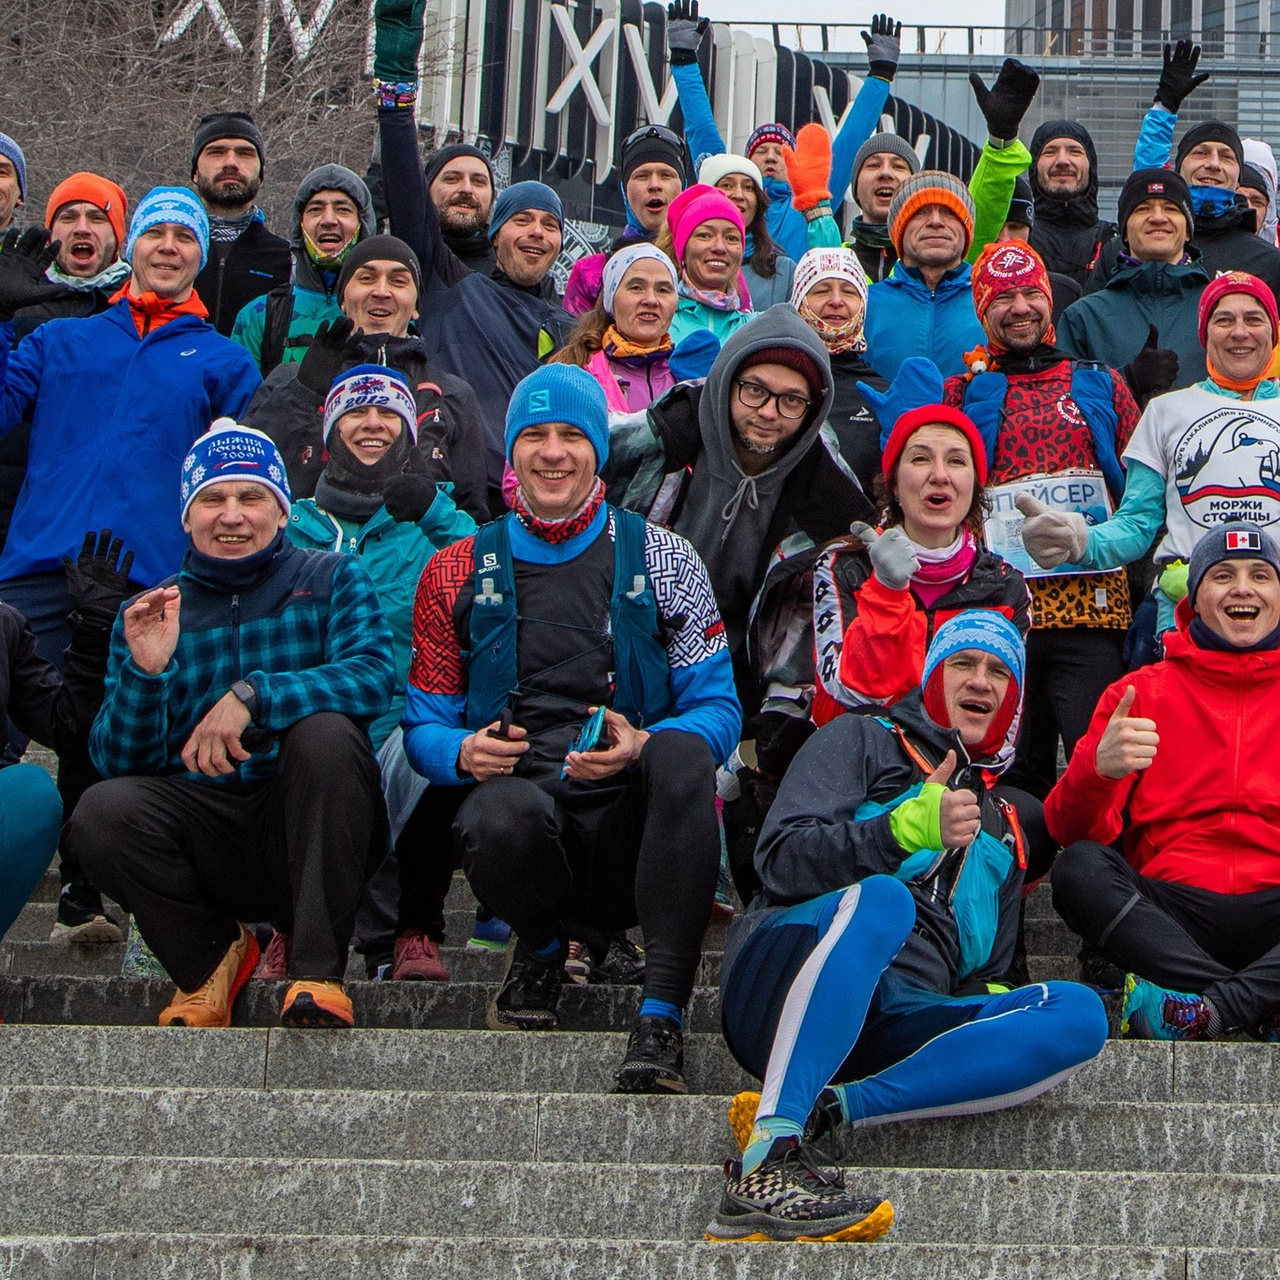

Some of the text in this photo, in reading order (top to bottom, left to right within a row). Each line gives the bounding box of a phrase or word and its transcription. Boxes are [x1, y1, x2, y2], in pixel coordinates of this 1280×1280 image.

[344, 395, 390, 410] 2012
[996, 483, 1095, 512] ПЙСЕР
[1210, 501, 1263, 511] МОРЖИ
